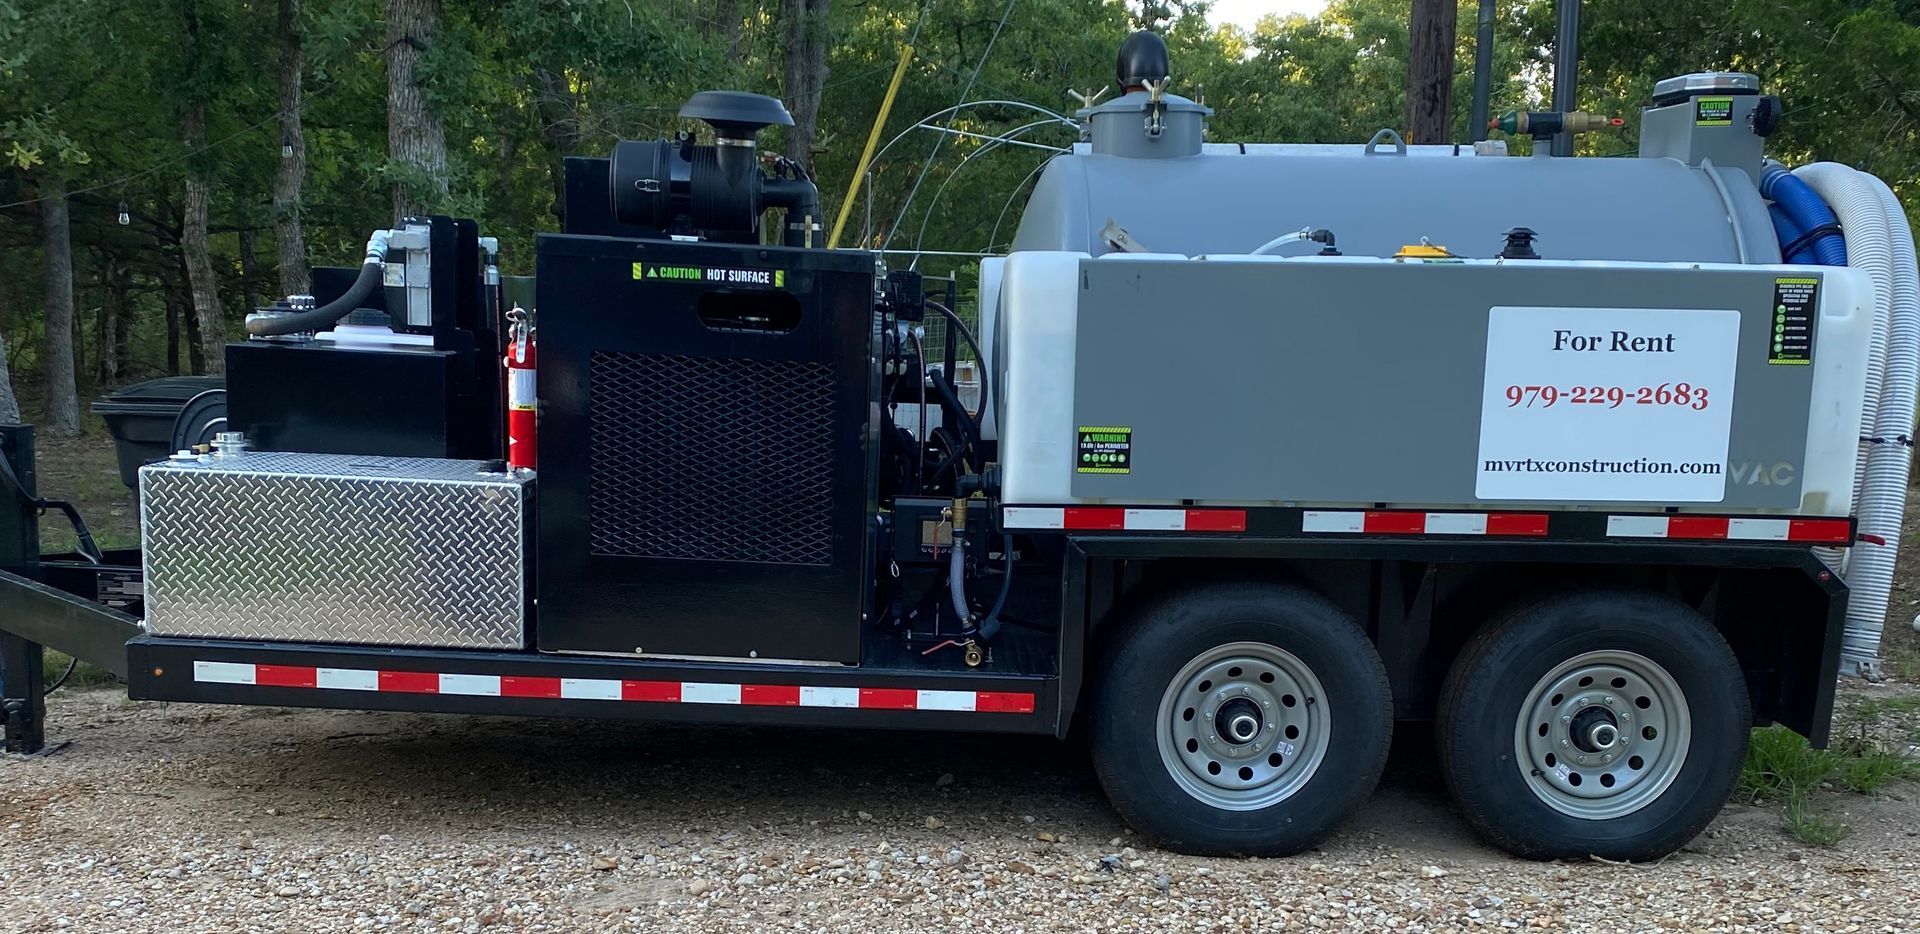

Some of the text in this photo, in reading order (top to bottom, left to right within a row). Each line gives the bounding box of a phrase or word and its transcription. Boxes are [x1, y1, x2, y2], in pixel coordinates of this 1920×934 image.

[660, 267, 770, 284] CAUTION HOT SURFACE
[1552, 329, 1676, 353] For Rent
[1505, 382, 1709, 411] 979-229-2683
[1092, 434, 1126, 442] WARNING
[1483, 457, 1722, 475] mvrtxconstruction.com
